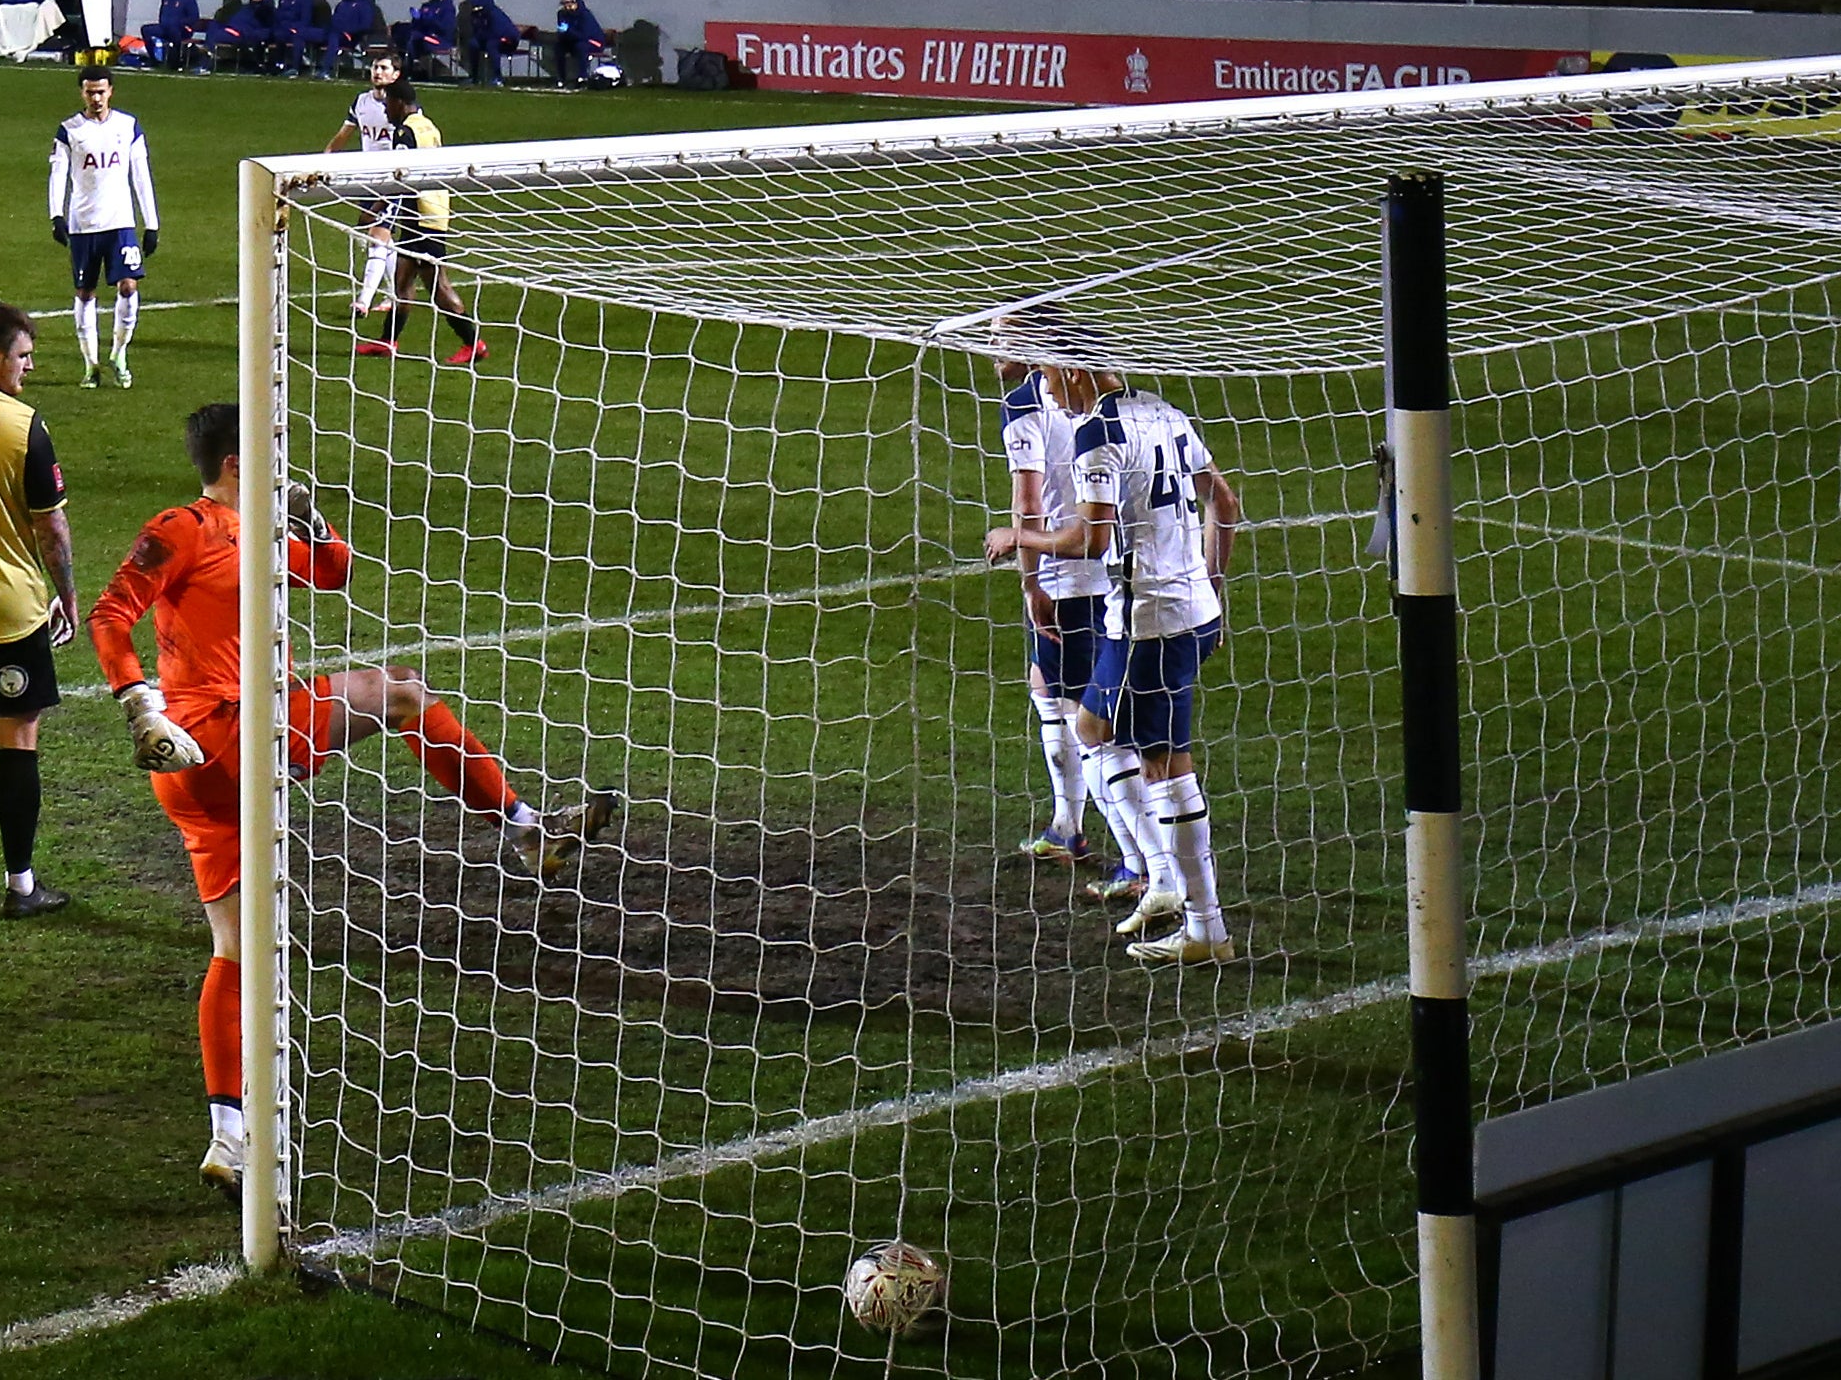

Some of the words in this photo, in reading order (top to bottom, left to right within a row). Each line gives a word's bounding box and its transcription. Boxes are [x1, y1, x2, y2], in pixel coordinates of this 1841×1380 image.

[736, 33, 906, 81] Emirates
[920, 39, 965, 83] FLY
[970, 41, 1068, 89] BETTER
[1214, 59, 1340, 93] Emirates
[1344, 63, 1386, 92] FA
[362, 125, 392, 141] AIA
[82, 151, 121, 170] AIA
[121, 246, 142, 266] 20
